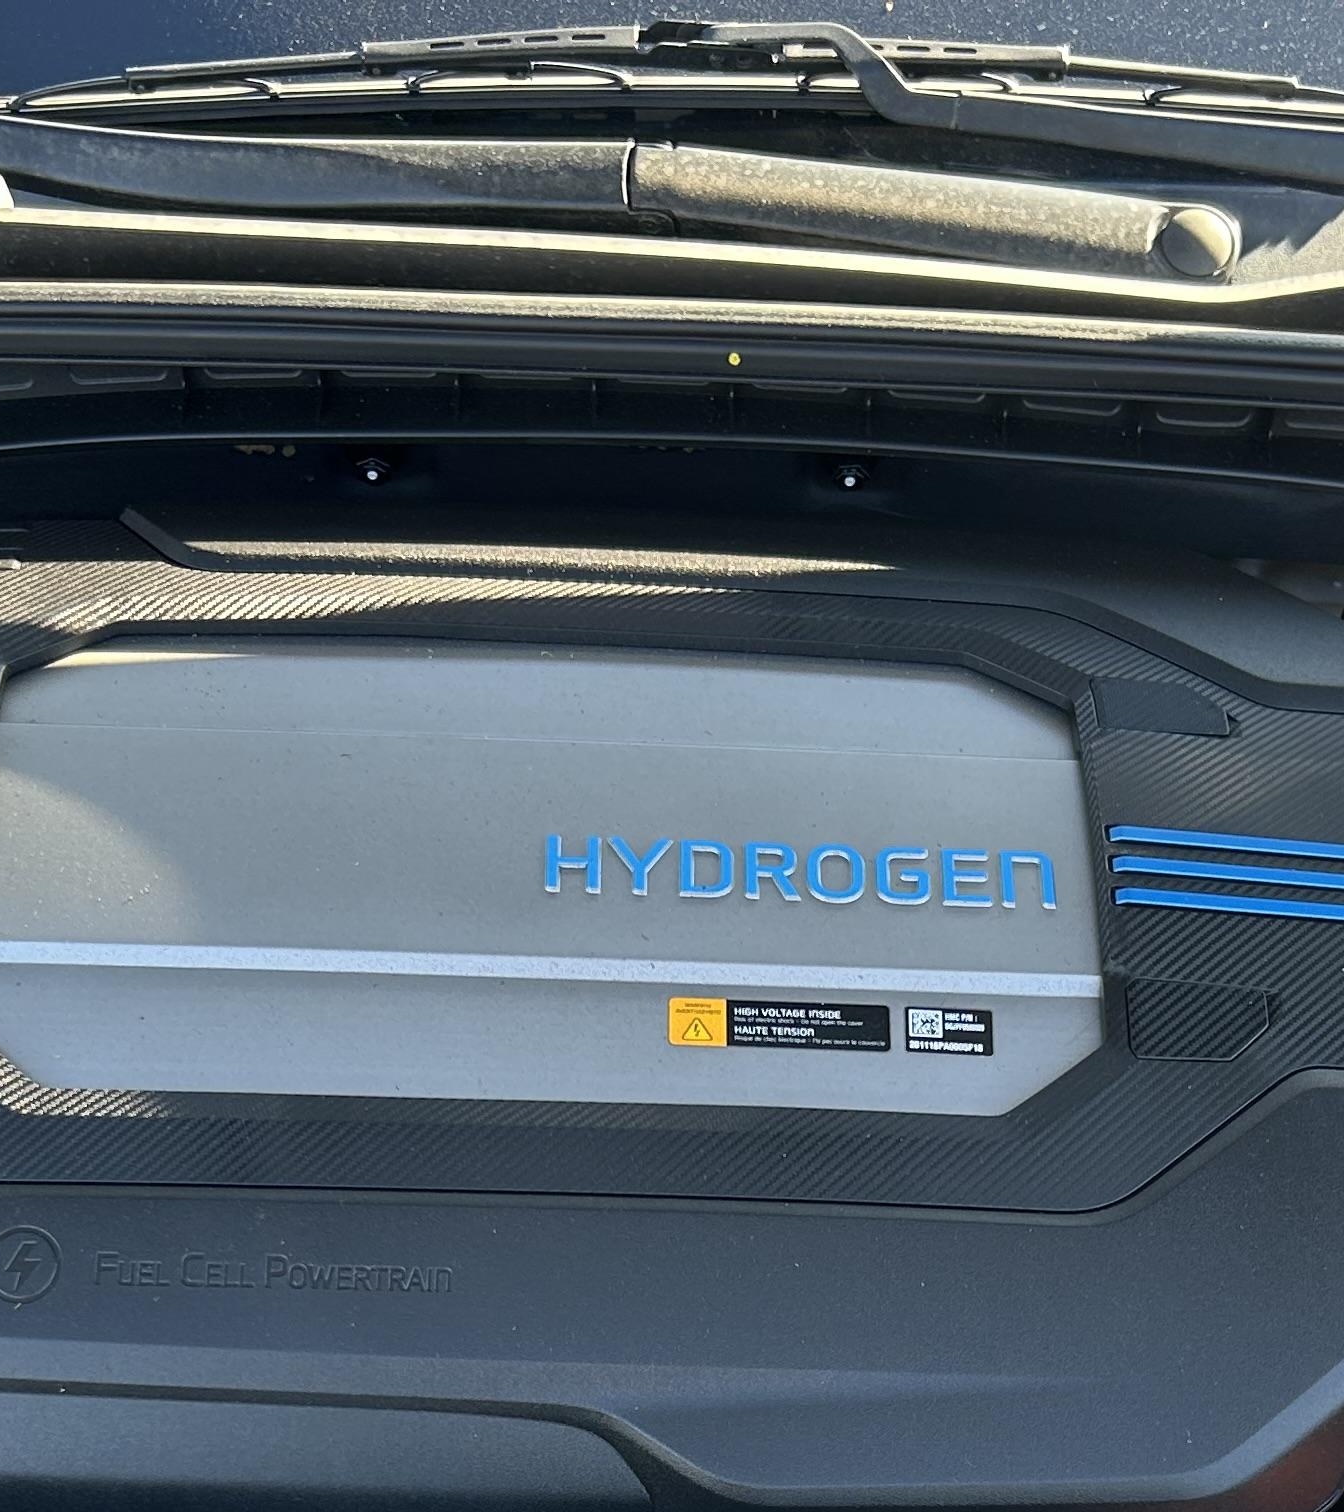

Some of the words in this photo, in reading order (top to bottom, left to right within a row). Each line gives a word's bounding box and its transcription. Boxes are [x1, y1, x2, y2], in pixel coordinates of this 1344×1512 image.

[544, 835, 1056, 909] HYDROGEN
[734, 1007, 759, 1017] HIGH
[761, 1008, 806, 1018] VOLTAGE
[809, 1009, 841, 1019] INSIDE
[734, 1025, 768, 1036] HAUTE
[771, 1027, 815, 1037] TENSION
